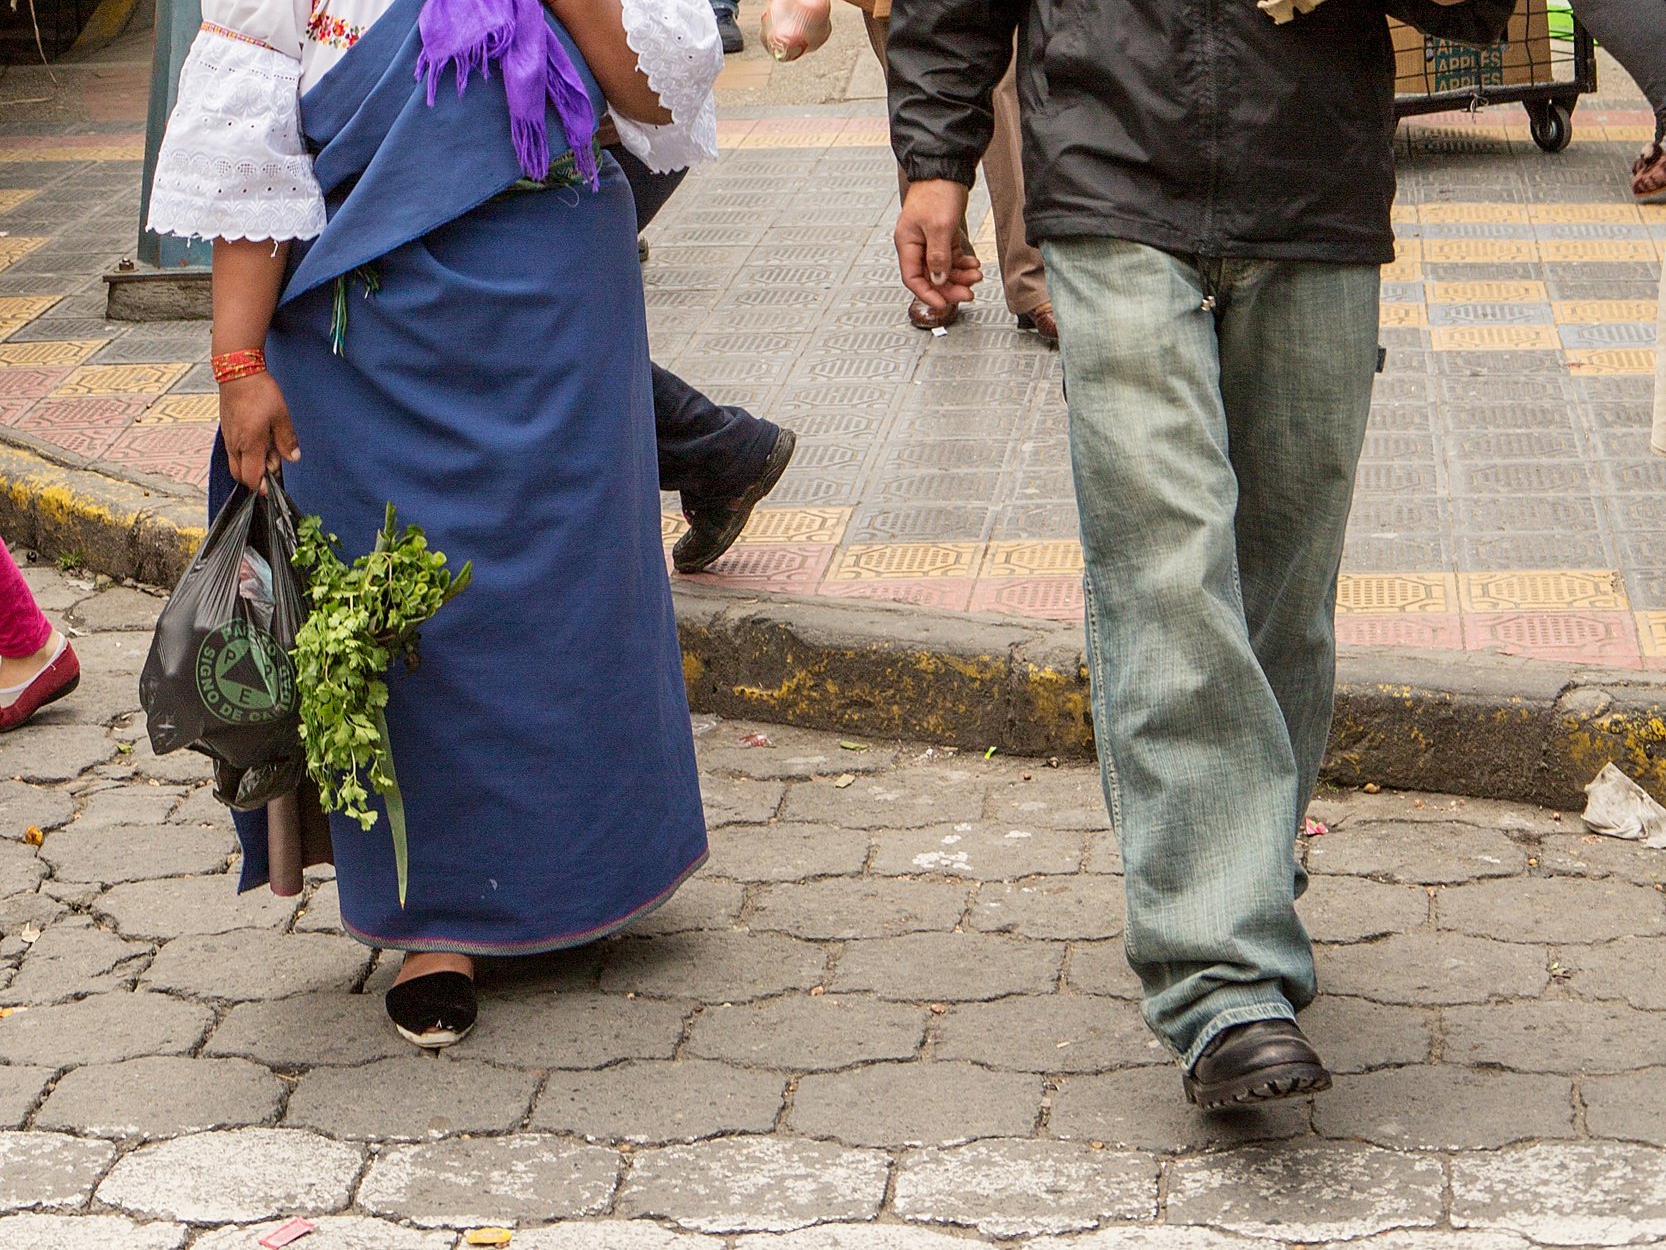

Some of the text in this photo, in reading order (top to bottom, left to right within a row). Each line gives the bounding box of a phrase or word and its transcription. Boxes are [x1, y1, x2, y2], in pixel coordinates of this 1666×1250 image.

[1437, 50, 1501, 76] APPLES
[199, 646, 220, 704] SIGNO
[219, 703, 244, 722] DE
